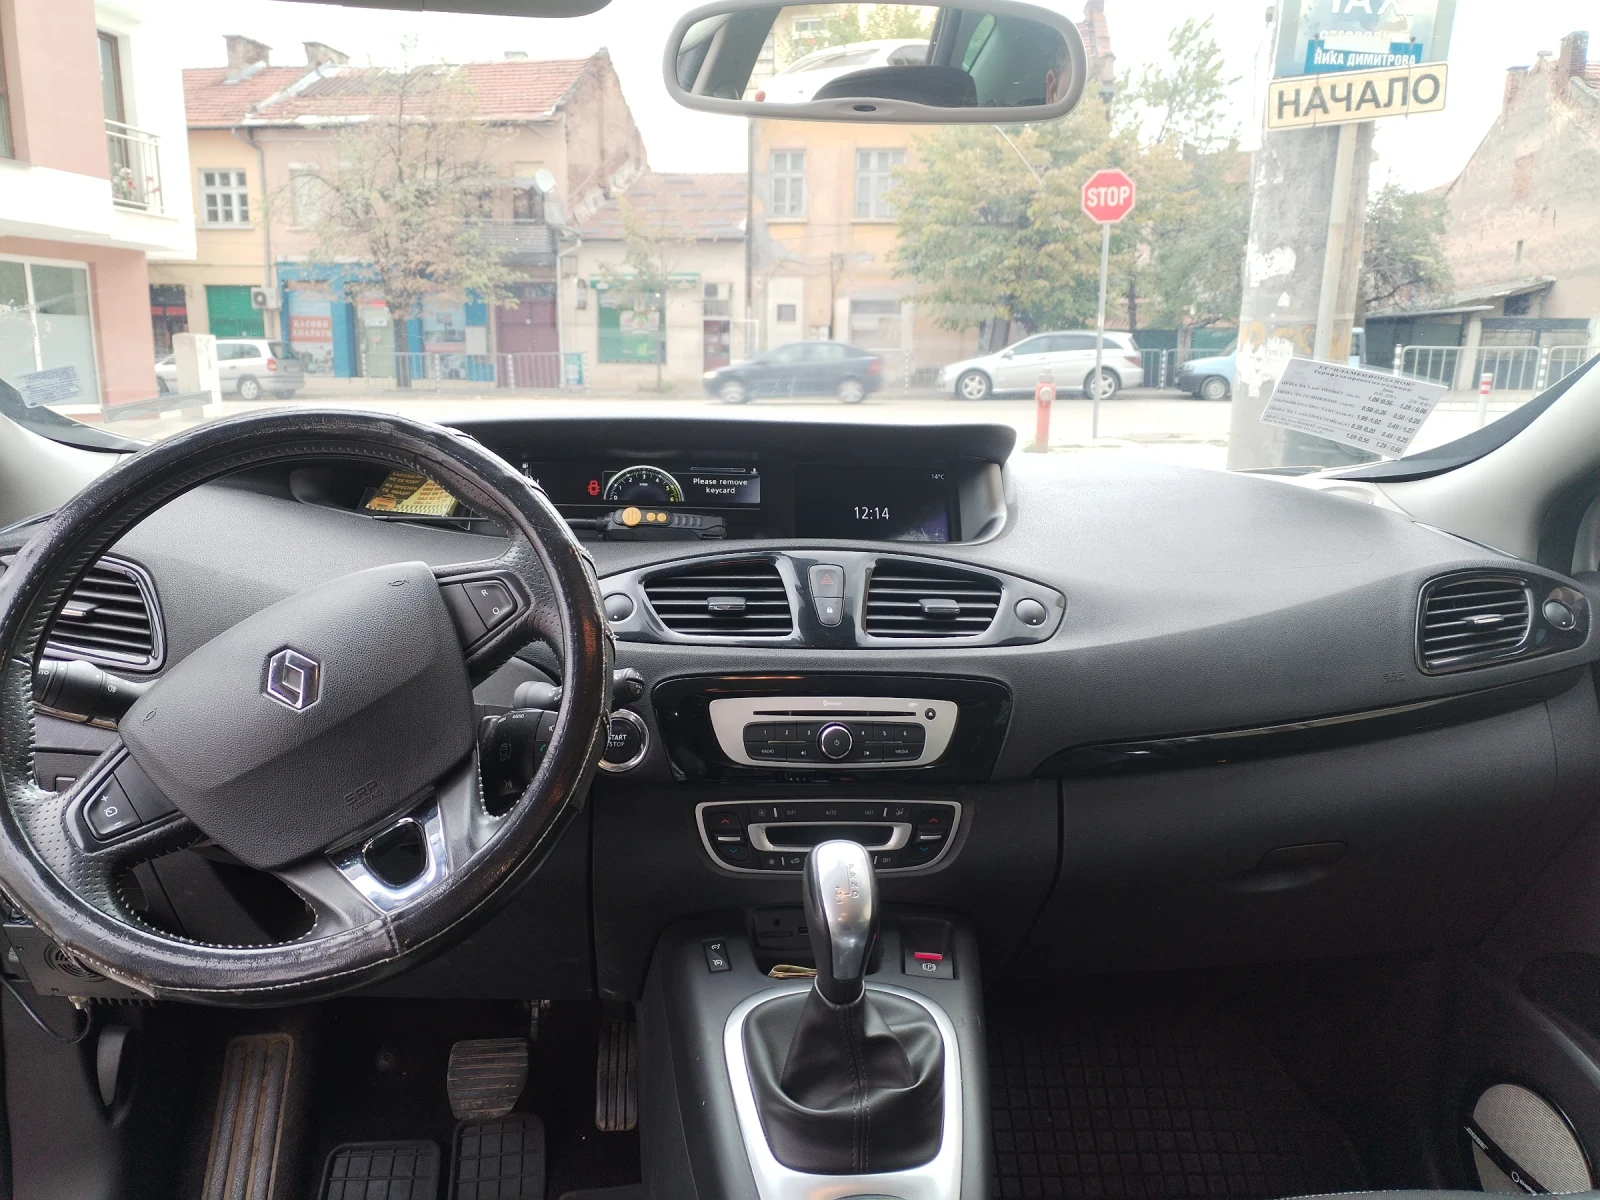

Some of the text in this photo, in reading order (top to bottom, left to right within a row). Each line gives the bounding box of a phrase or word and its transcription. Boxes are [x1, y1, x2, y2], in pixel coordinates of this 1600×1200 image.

[1347, 54, 1416, 67] ДИМИТРОВА
[1277, 73, 1440, 120] НАЧАЛО
[1087, 186, 1130, 208] STOP
[693, 478, 717, 486] Please
[705, 486, 736, 494] keycard
[853, 506, 890, 521] 12:14
[481, 589, 489, 597] R
[852, 890, 860, 899] D
